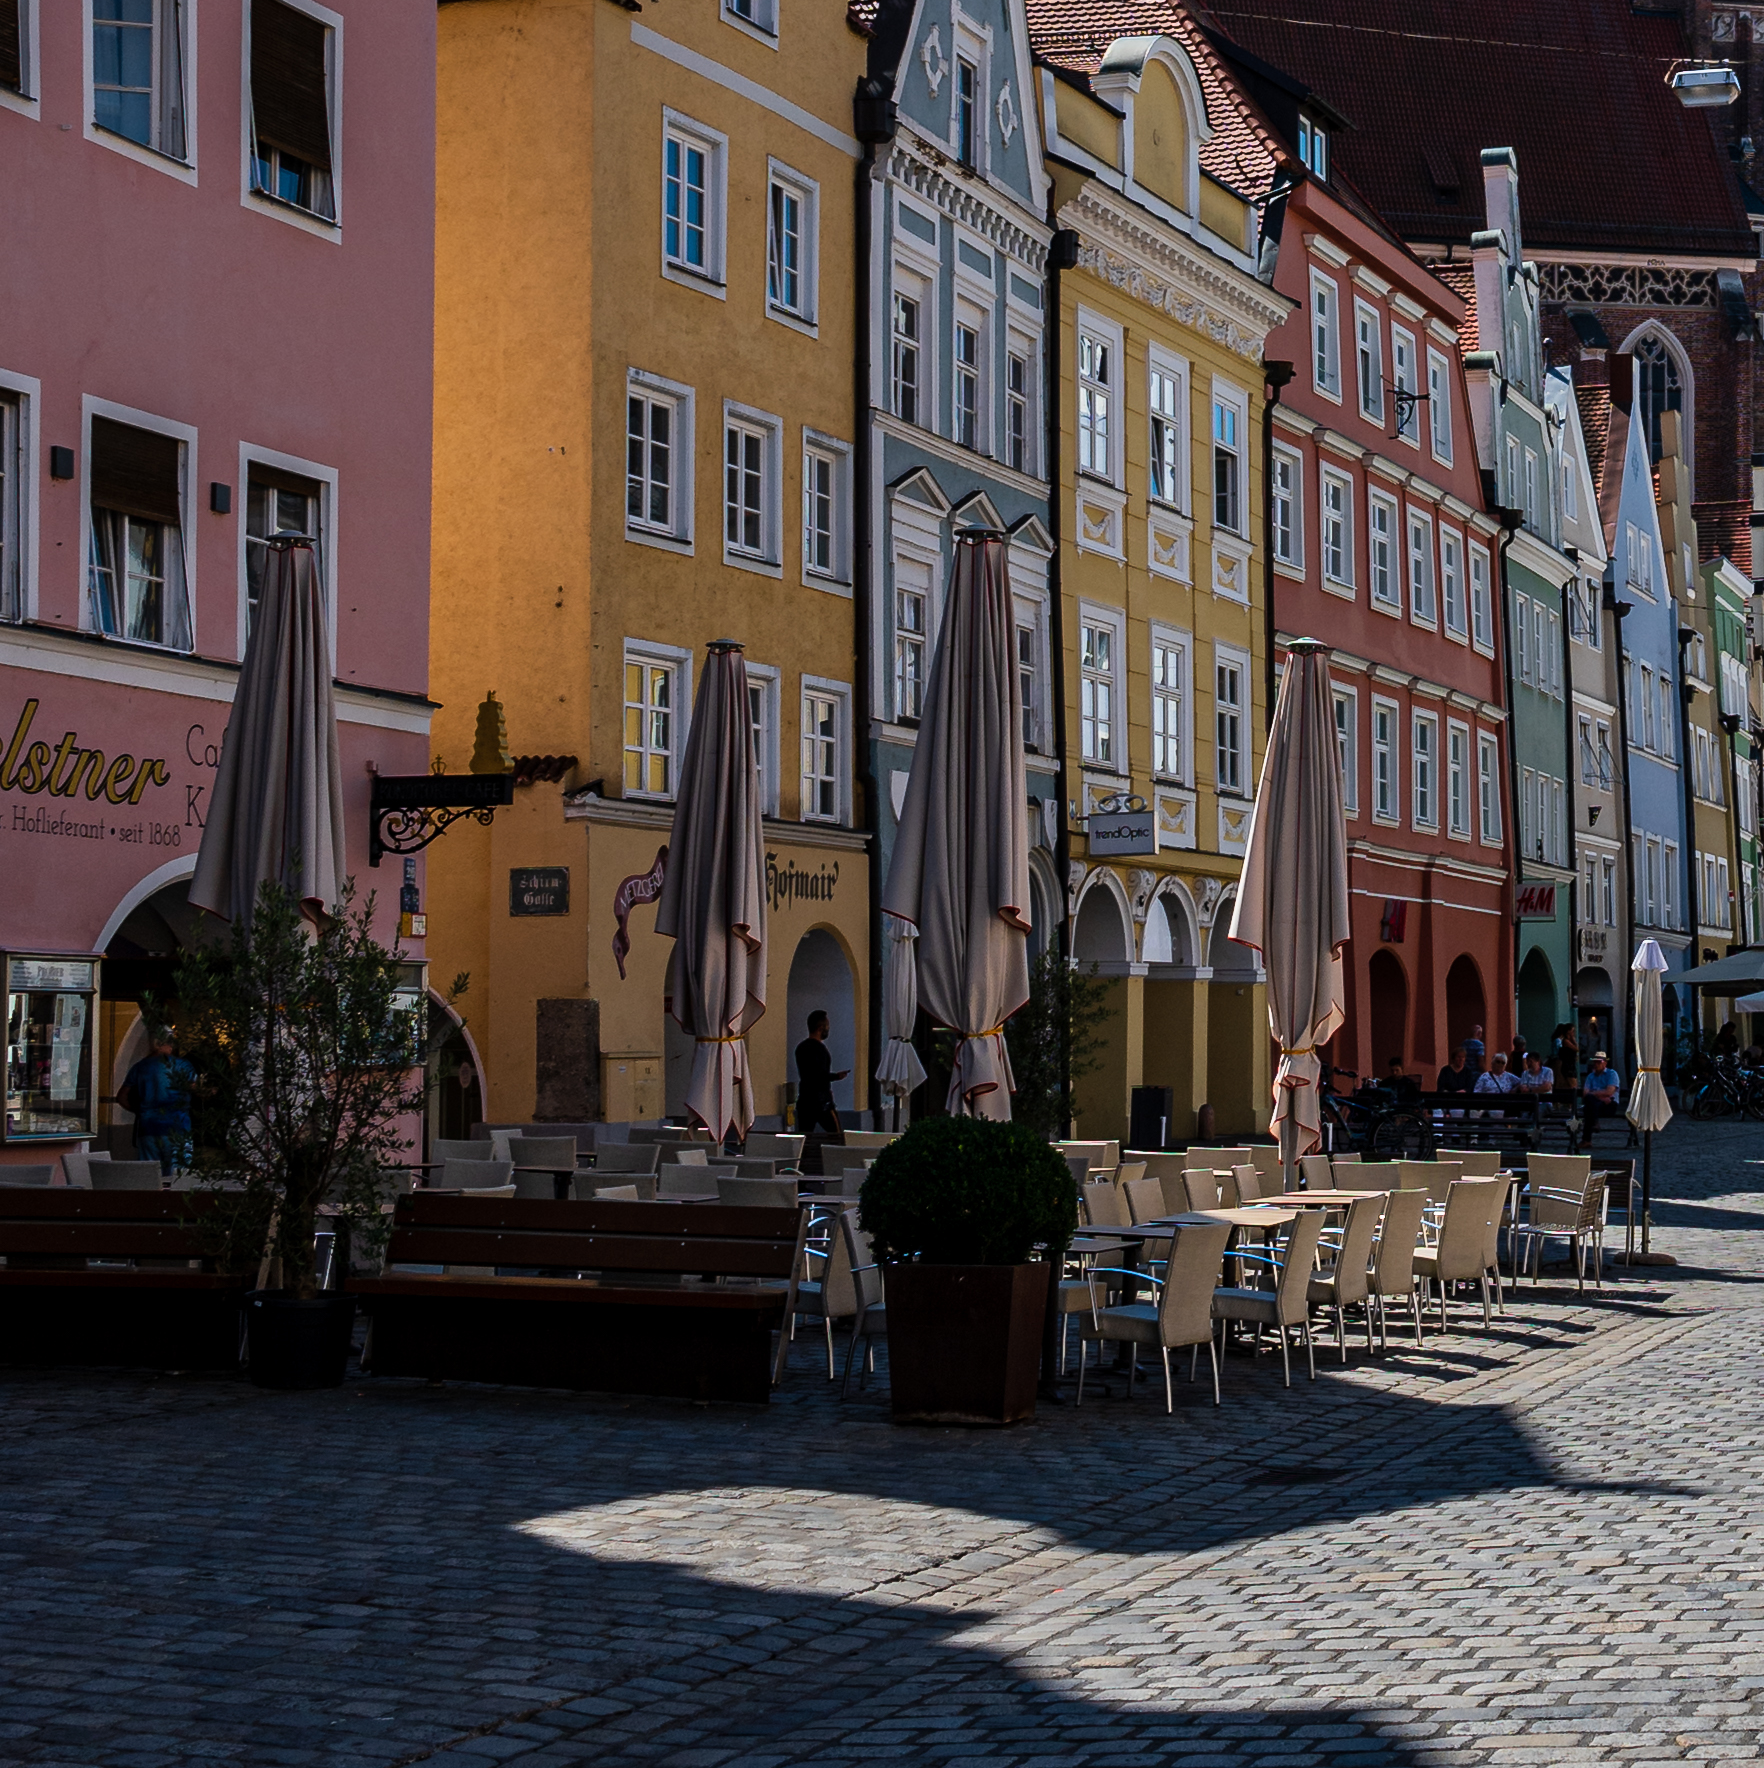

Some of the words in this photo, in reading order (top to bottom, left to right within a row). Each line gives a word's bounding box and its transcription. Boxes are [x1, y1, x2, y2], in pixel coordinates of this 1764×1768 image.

[0, 698, 170, 805] lstner
[12, 805, 105, 840] Hoflieferant
[119, 822, 143, 844] seit
[149, 822, 181, 847] 1868
[1095, 826, 1149, 841] trendOptic
[1517, 887, 1554, 913] H&M
